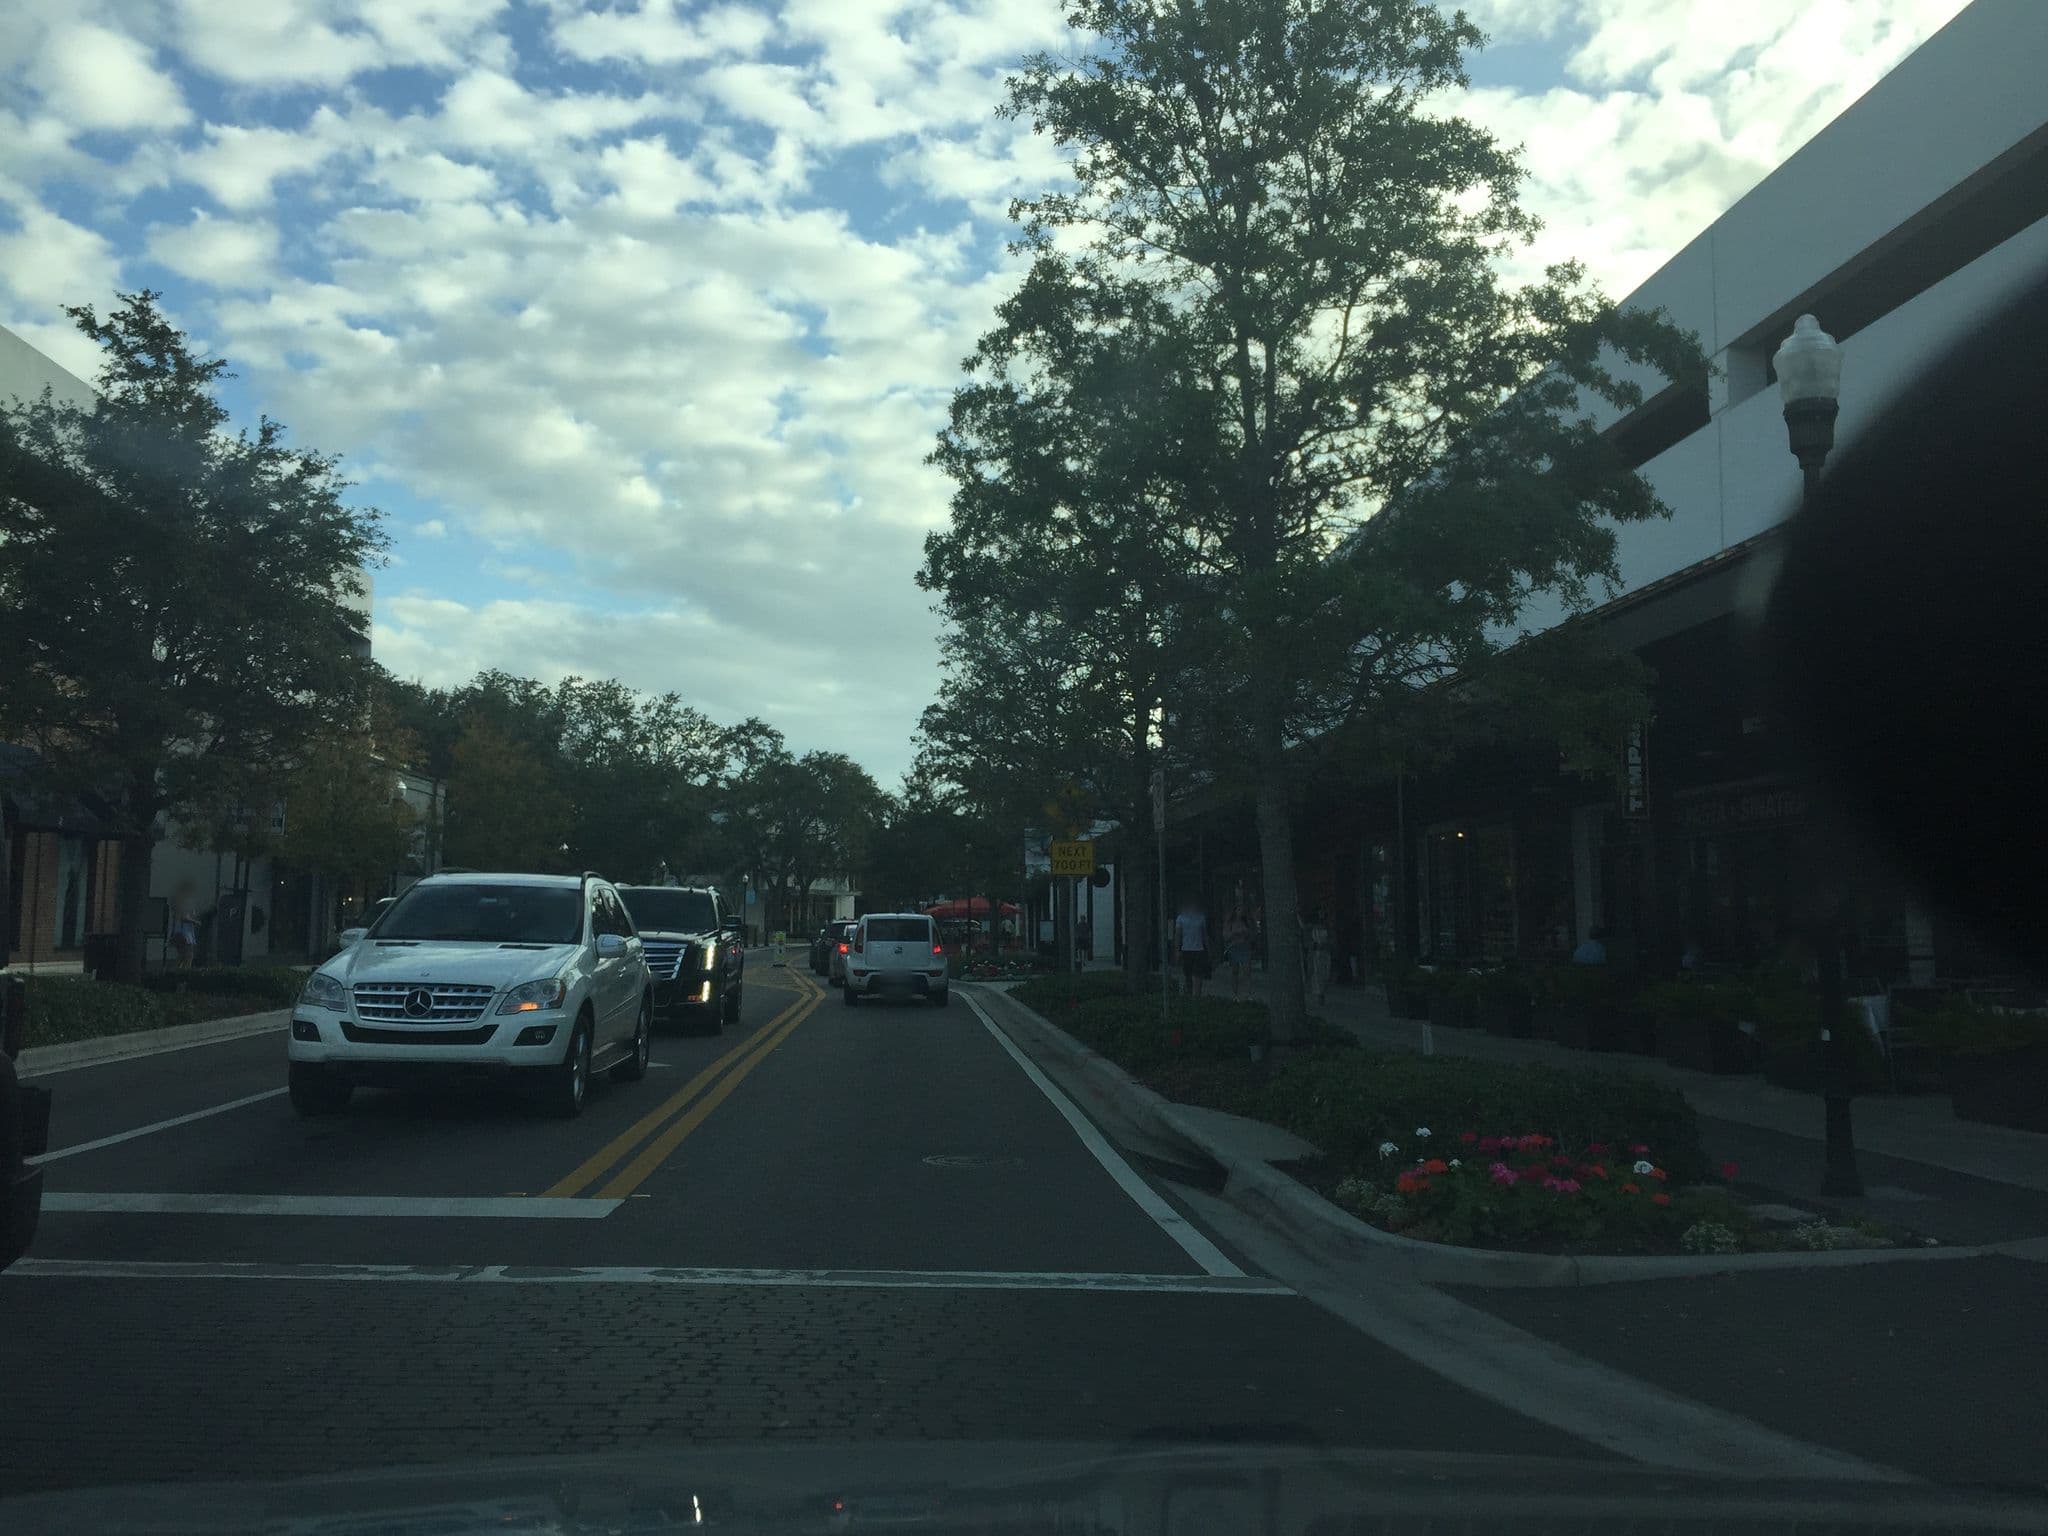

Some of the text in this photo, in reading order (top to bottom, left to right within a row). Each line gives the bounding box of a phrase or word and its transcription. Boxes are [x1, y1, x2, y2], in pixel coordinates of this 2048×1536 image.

[1058, 845, 1087, 857] NEXT
[1054, 859, 1092, 871] 700 FT
